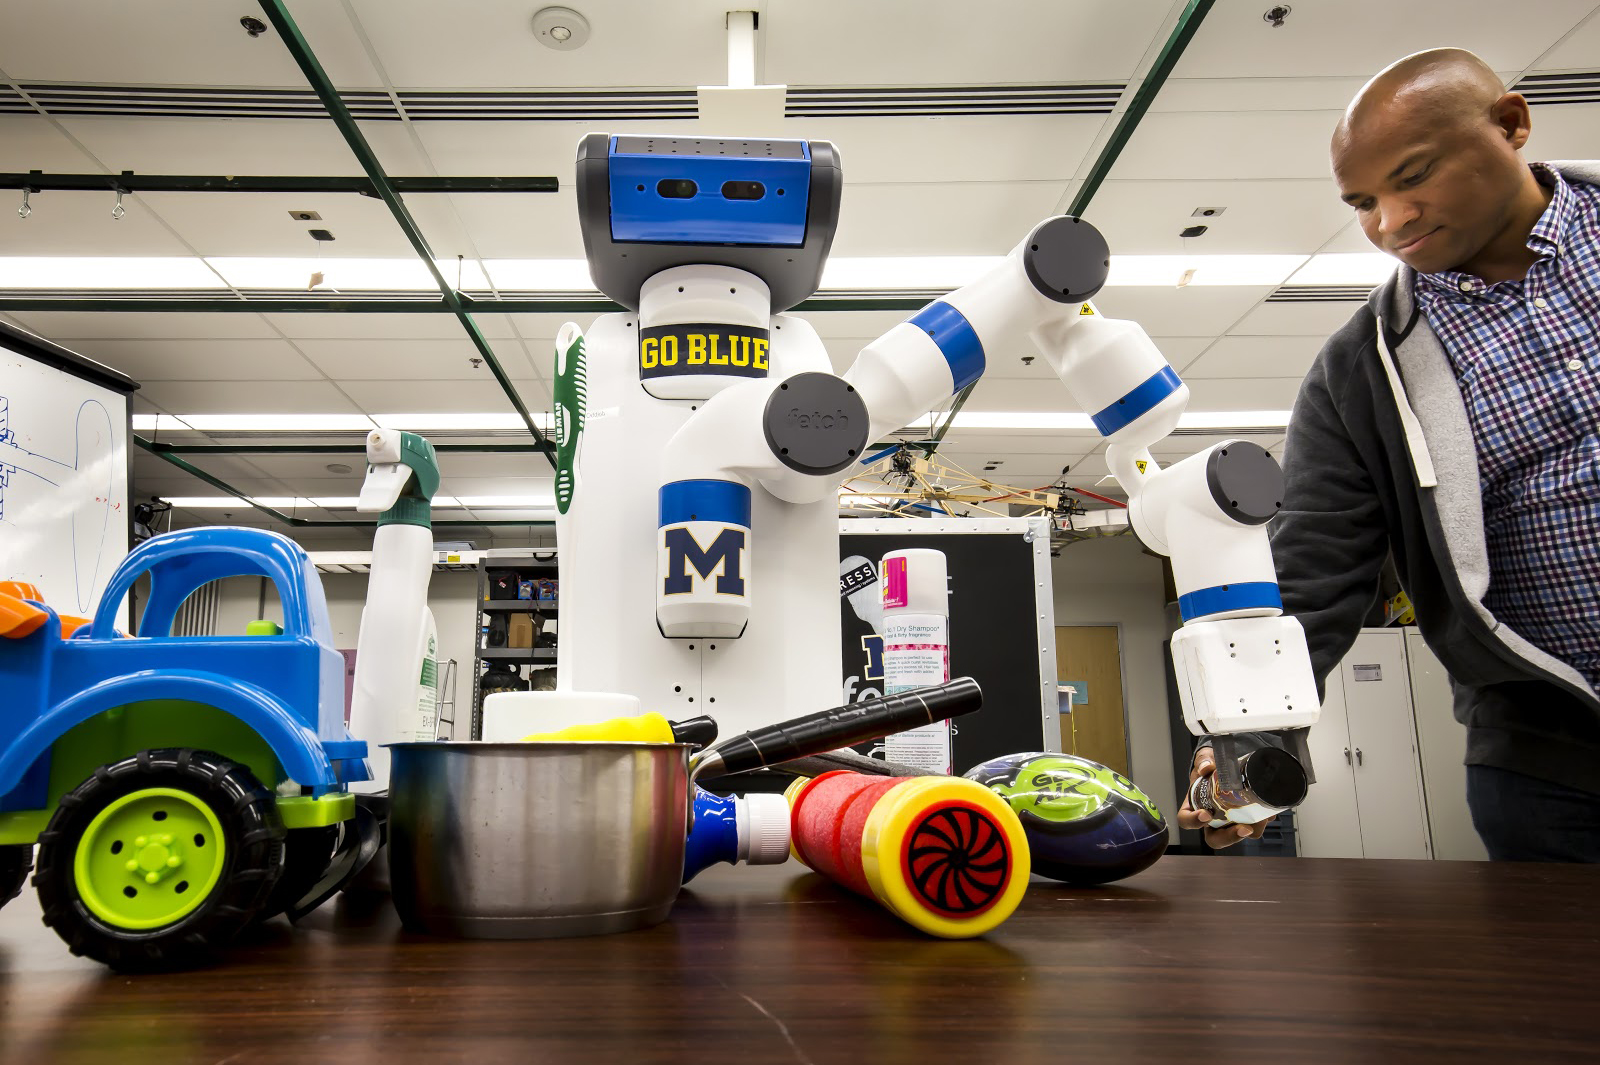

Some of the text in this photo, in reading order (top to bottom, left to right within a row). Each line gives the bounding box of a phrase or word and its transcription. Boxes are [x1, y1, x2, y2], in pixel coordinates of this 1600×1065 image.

[641, 334, 769, 370] GO BLUE
[555, 402, 563, 444] LIBMAN
[788, 408, 848, 431] fetch
[664, 527, 745, 597] M
